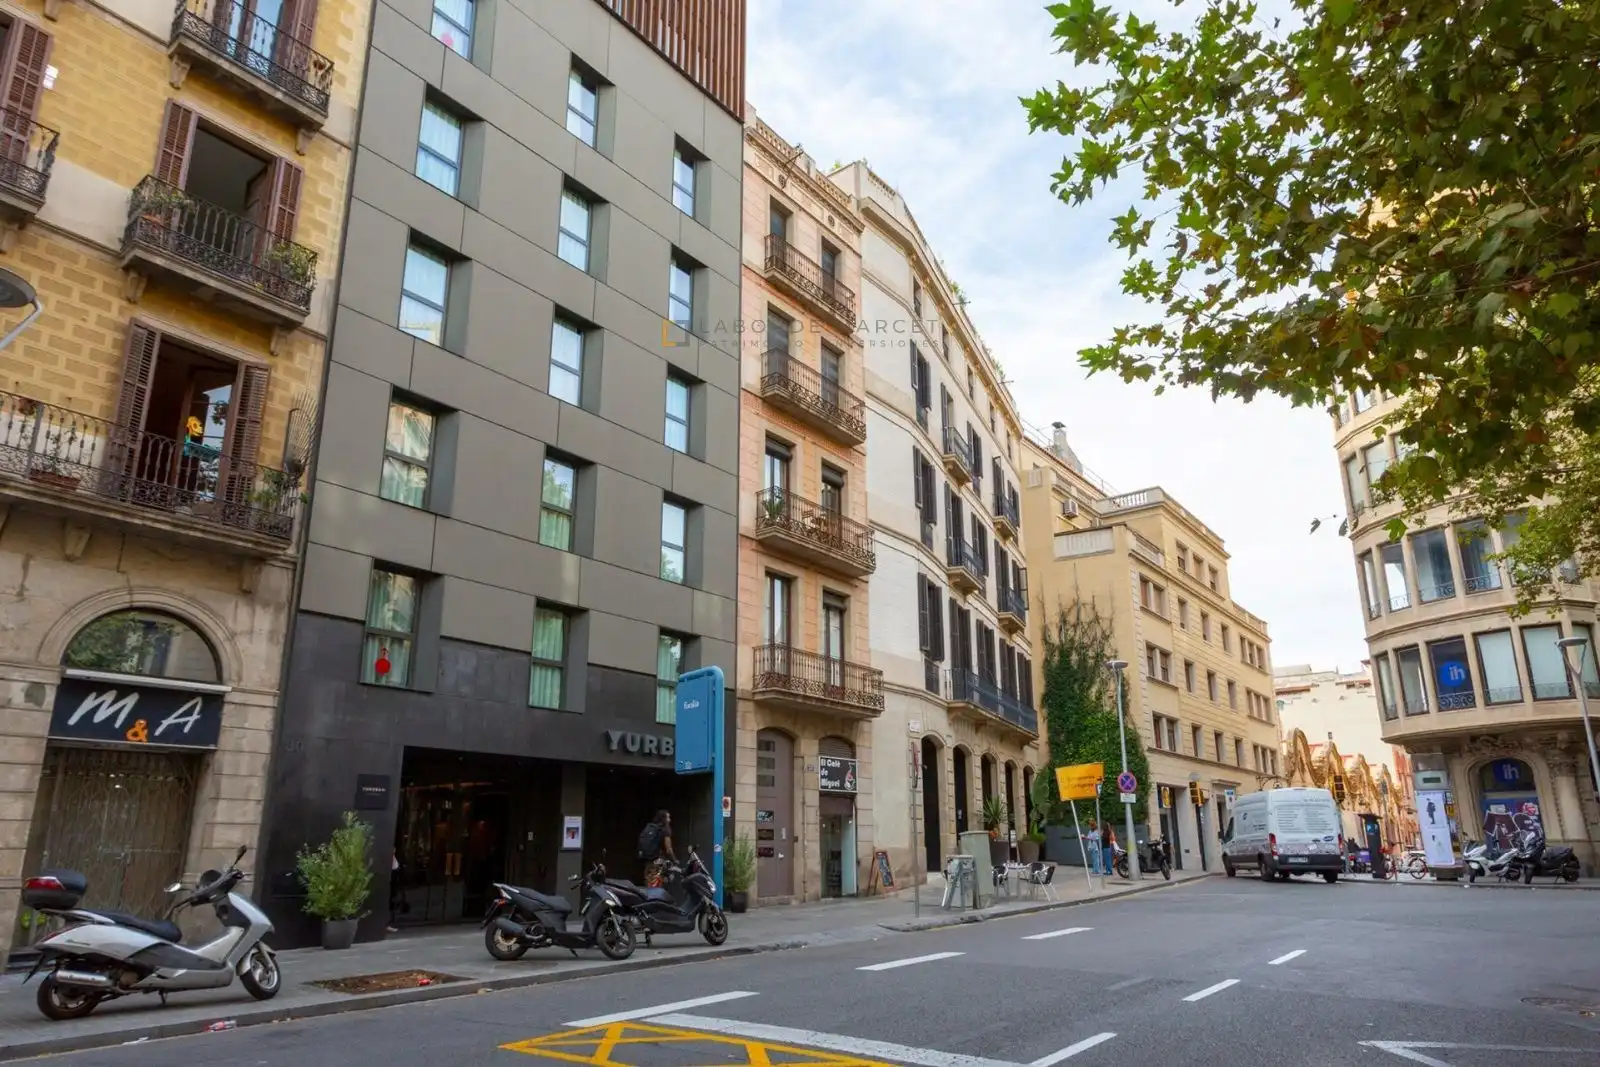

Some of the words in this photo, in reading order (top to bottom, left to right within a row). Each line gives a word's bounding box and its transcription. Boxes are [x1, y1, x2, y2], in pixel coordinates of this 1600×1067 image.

[67, 689, 140, 729] M
[125, 719, 148, 744] &
[153, 696, 203, 736] A
